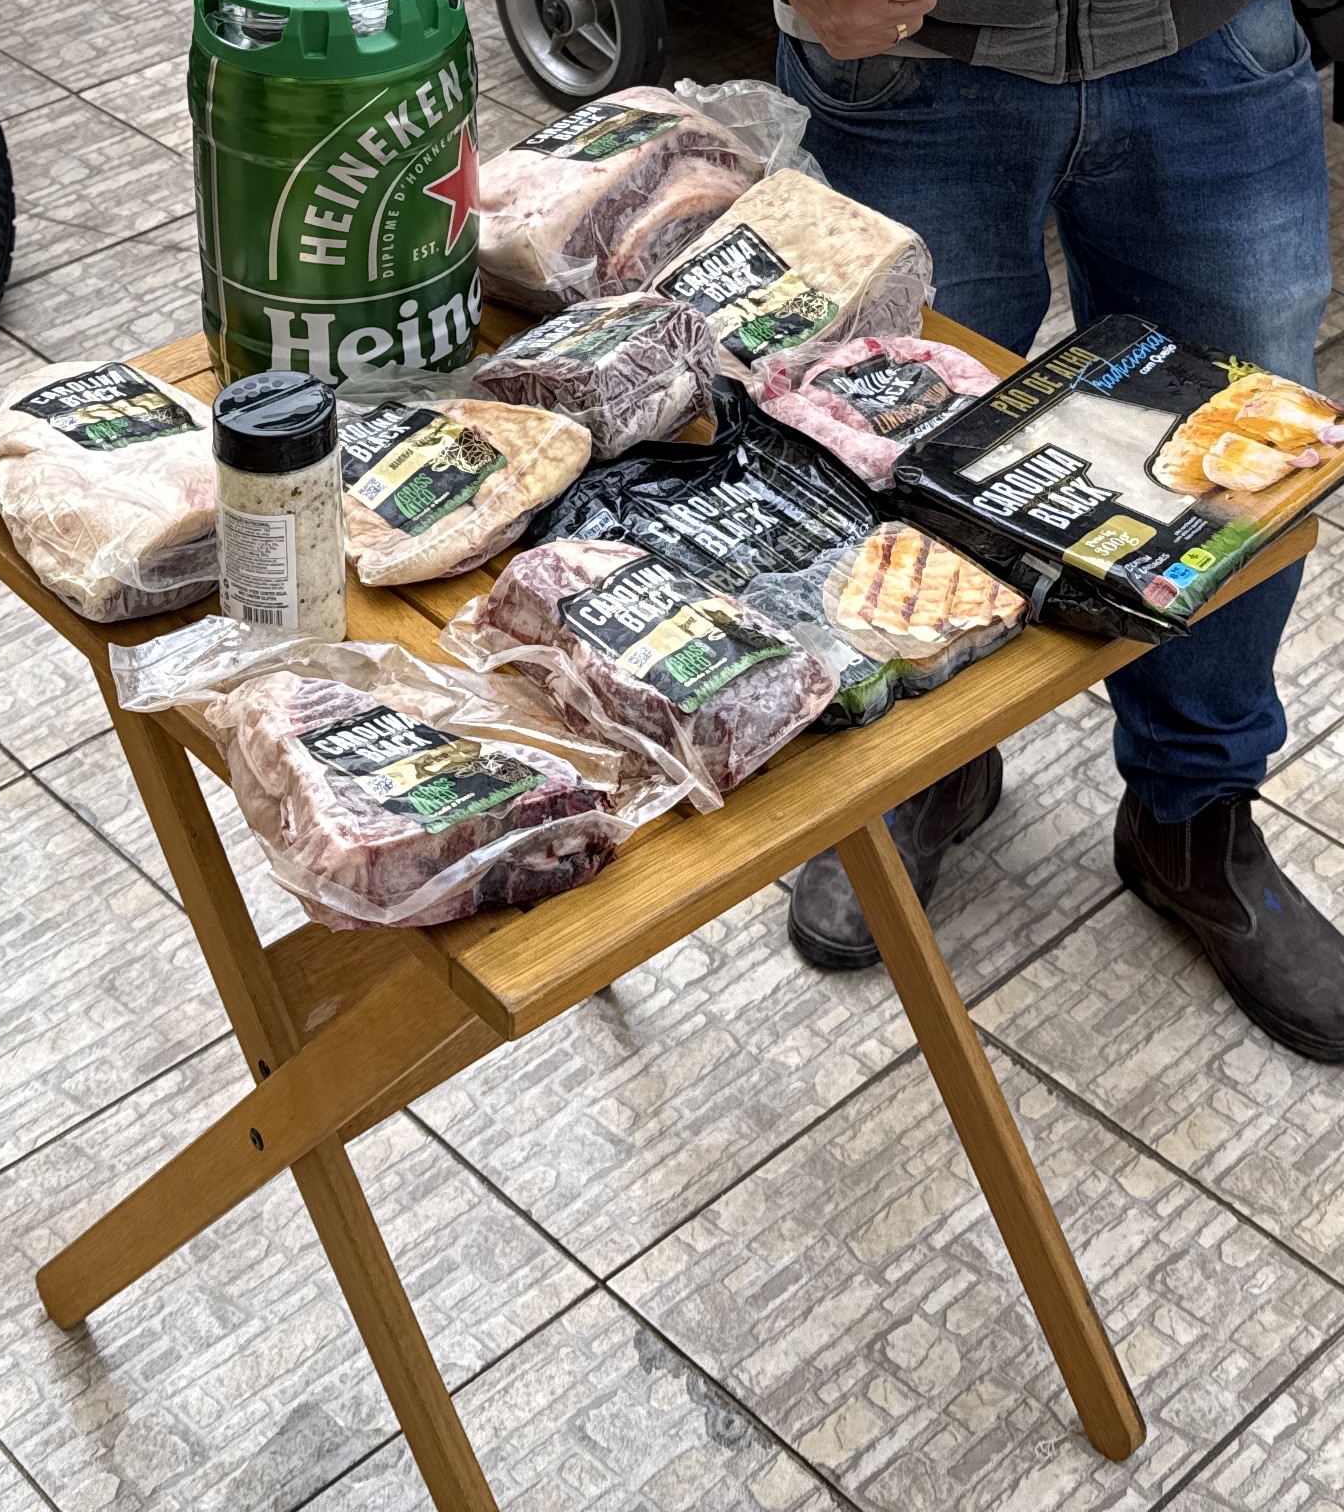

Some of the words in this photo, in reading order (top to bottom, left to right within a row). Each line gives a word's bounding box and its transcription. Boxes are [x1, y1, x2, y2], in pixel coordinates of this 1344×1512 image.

[525, 105, 603, 145] CAROLINA
[552, 113, 607, 141] BLACK
[299, 59, 464, 266] HEINEKEN
[381, 209, 401, 279] DIPLOME
[412, 240, 440, 263] EST.
[674, 239, 757, 297] CAROLINA
[1139, 361, 1156, 375] com
[1150, 343, 1178, 364] Queijo
[30, 370, 128, 405] CAROLINA
[58, 385, 128, 408] BLACK
[989, 388, 1041, 419] PÃO
[1022, 372, 1064, 395] DE
[1045, 346, 1101, 379] ALHO
[347, 424, 412, 463] BLACK
[972, 447, 1085, 517] CAROLINA
[1027, 476, 1113, 530] BLACK
[694, 501, 780, 558] BLACK
[1093, 531, 1141, 557] 300g
[579, 563, 677, 627] CAROLINA
[615, 582, 688, 634] BLACK
[313, 711, 421, 756] CAROLINA
[355, 730, 433, 763] BLACK
